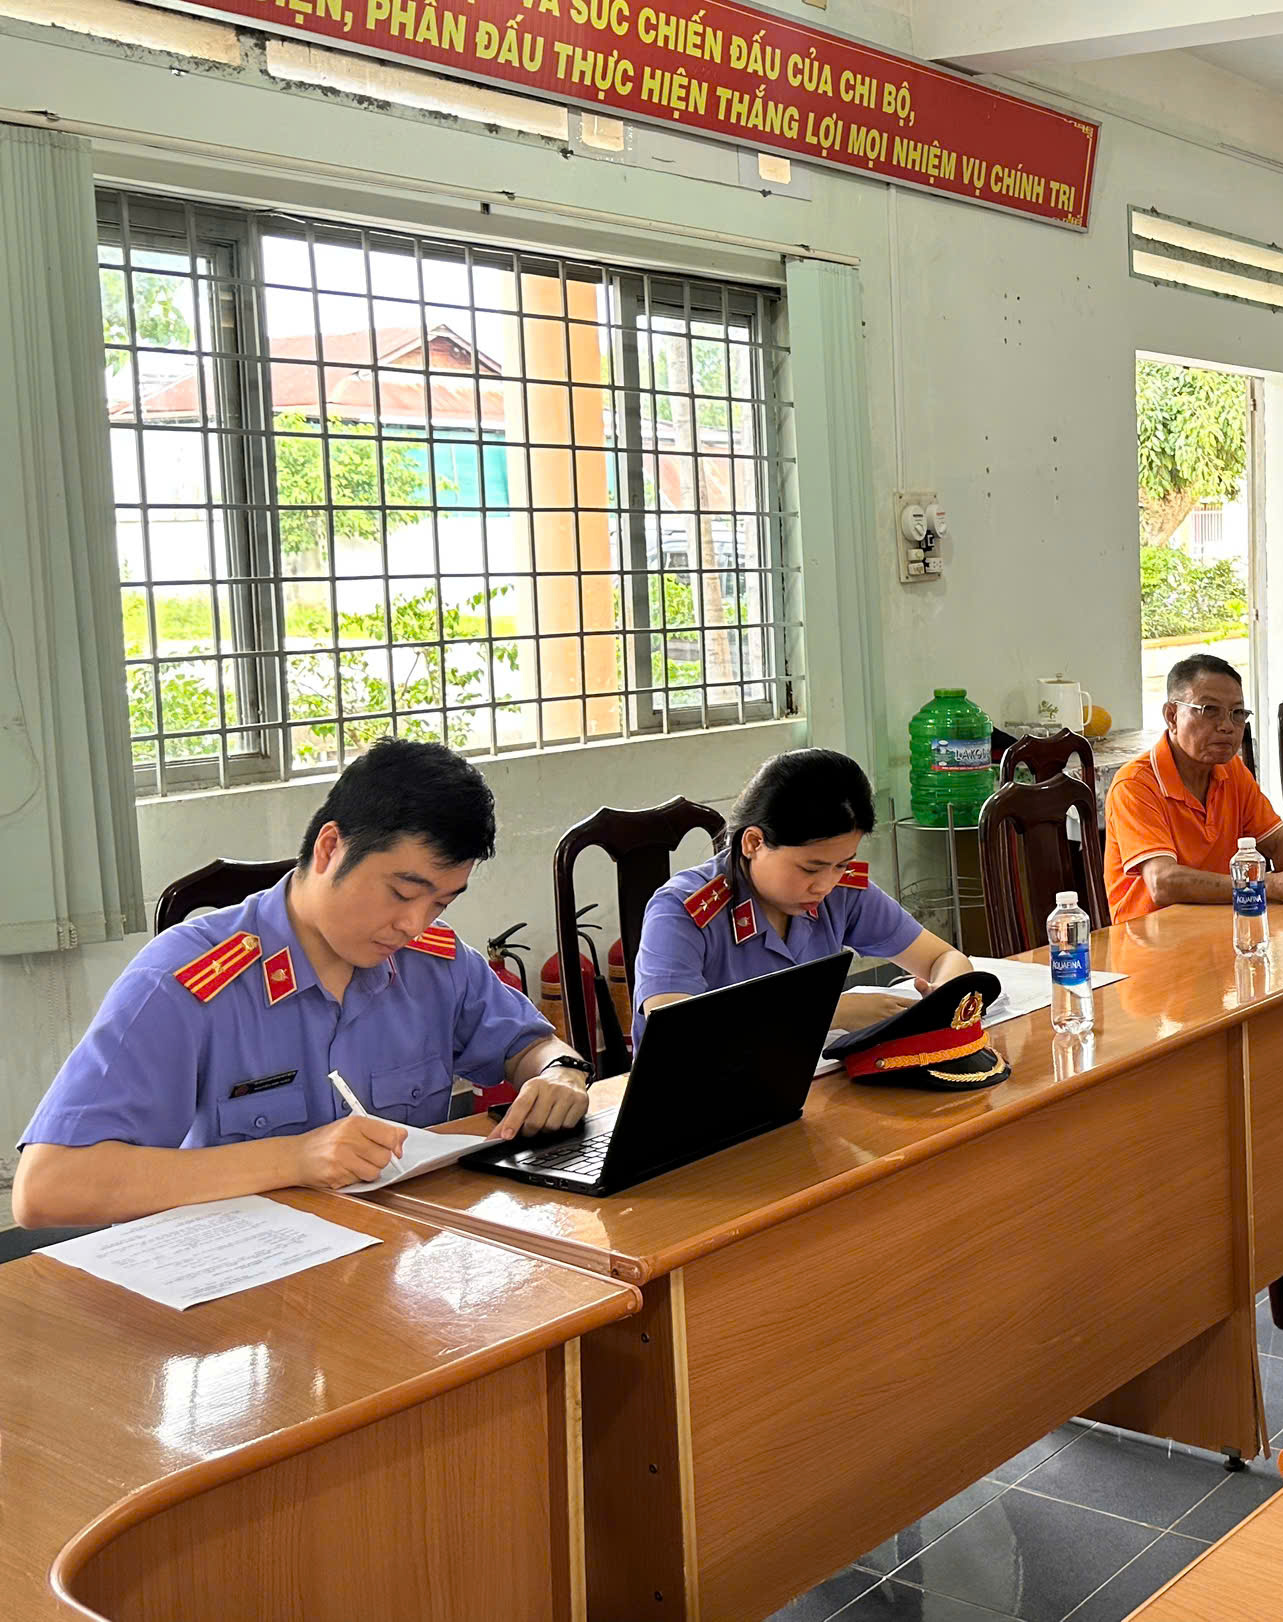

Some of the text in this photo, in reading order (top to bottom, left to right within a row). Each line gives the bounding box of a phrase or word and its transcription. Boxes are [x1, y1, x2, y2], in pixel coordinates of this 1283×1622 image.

[475, 15, 545, 72] ĐẤU
[553, 41, 635, 99] THỰC
[641, 66, 709, 119] HIỆN
[715, 83, 800, 139] THẮNG
[805, 112, 844, 157] LỢI
[847, 124, 888, 168] MỌI
[892, 135, 957, 184] NHIỆM
[962, 155, 986, 196] VỤ
[990, 163, 1045, 204] CHÍNH
[1049, 180, 1075, 219] TRỊ
[637, 8, 723, 64] CHIẾN
[729, 30, 781, 81] ĐẤU
[787, 47, 833, 97] CỦA
[839, 70, 877, 109] CHI
[883, 81, 916, 126] BỘ,
